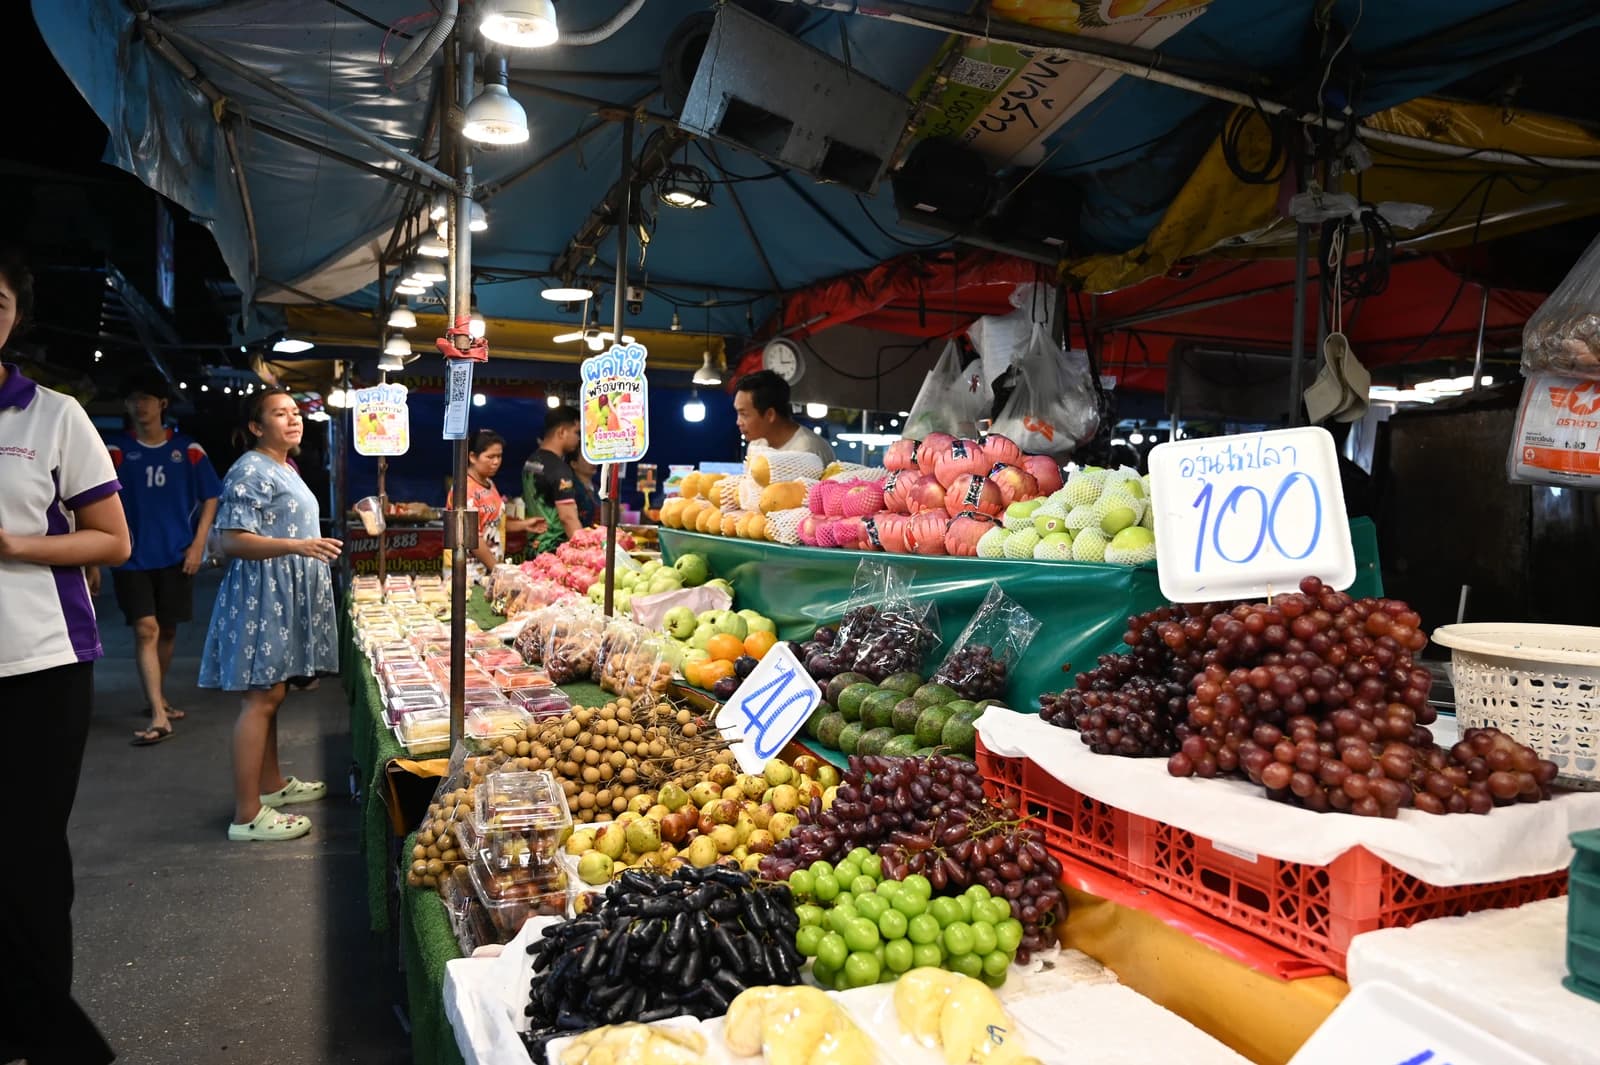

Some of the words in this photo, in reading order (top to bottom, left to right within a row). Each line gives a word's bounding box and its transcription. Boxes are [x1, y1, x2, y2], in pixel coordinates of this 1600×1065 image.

[585, 346, 641, 381] ผลไม้
[588, 381, 640, 398] พร้อมทาน
[145, 465, 166, 488] 16
[1193, 471, 1322, 573] 100
[741, 667, 815, 760] 40
